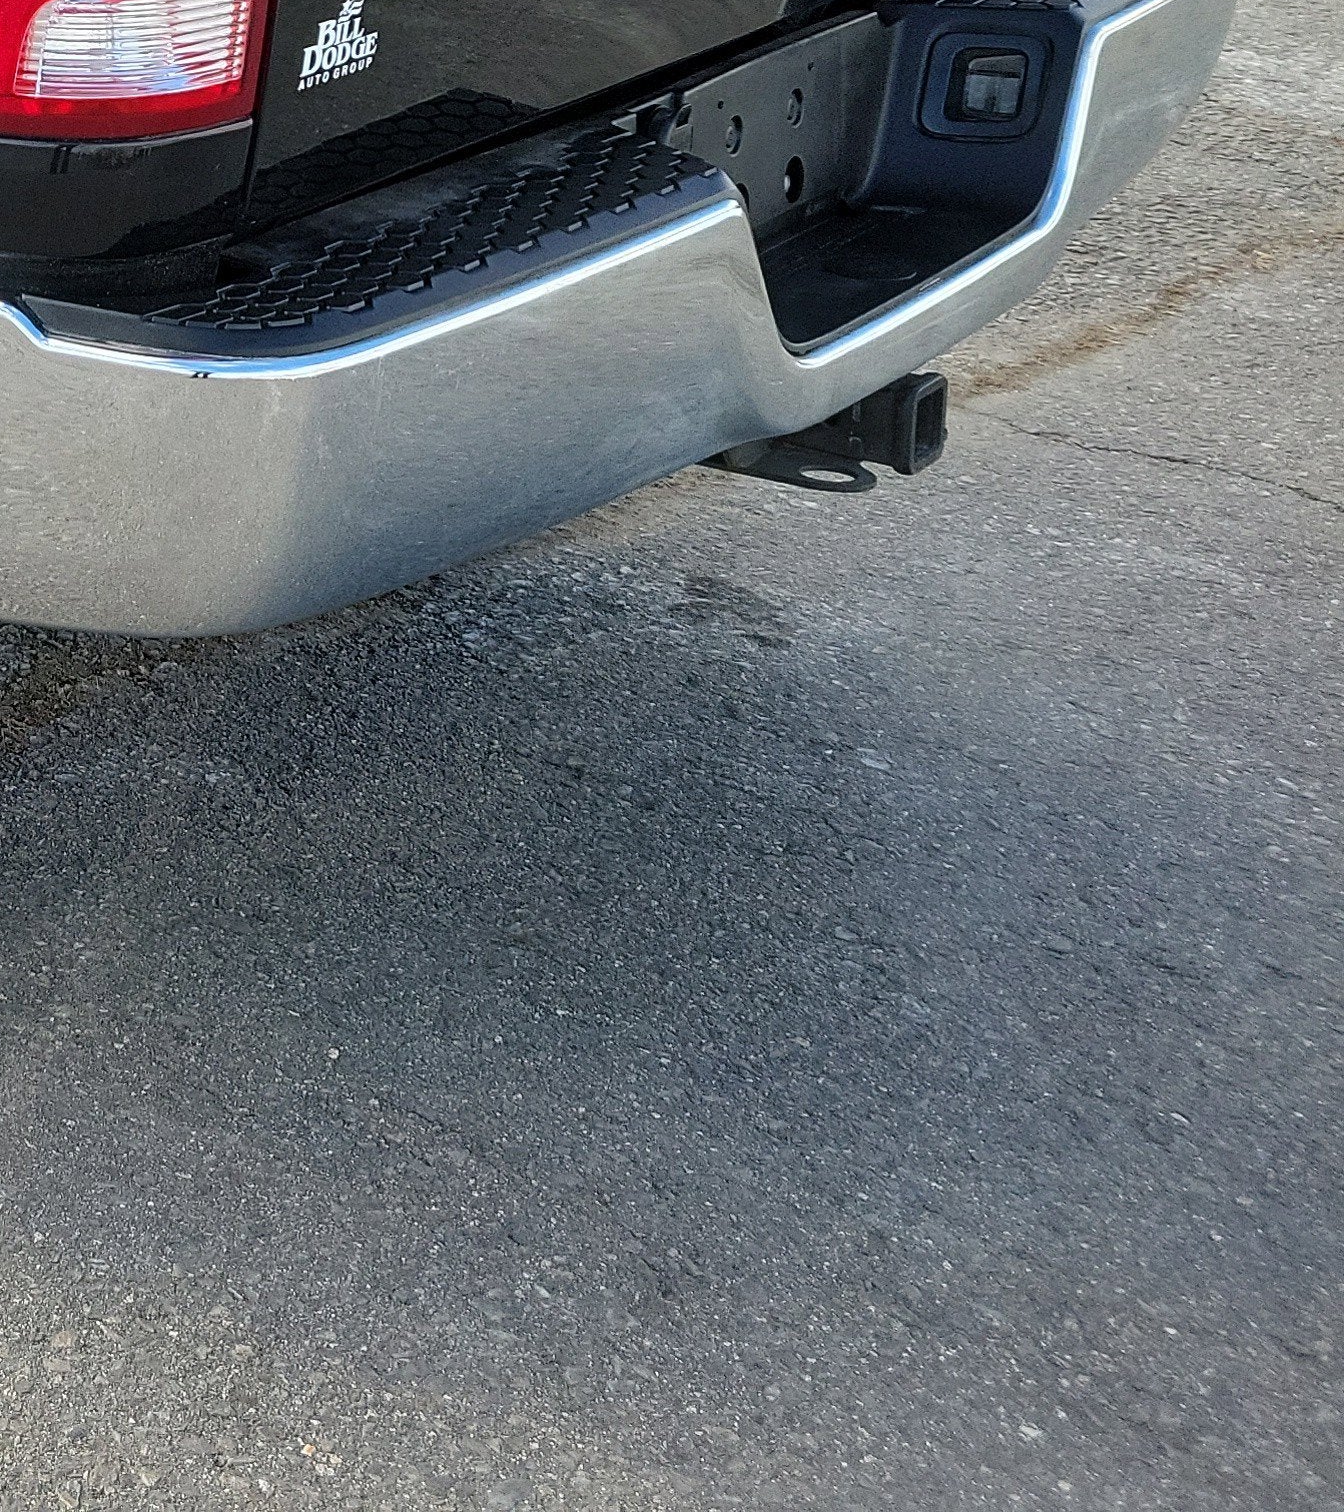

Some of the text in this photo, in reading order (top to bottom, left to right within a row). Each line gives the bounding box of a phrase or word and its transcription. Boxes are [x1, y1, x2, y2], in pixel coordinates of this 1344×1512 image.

[317, 16, 365, 49] BILL
[299, 31, 378, 77] DODGE
[297, 56, 373, 91] AUTO GROUP
